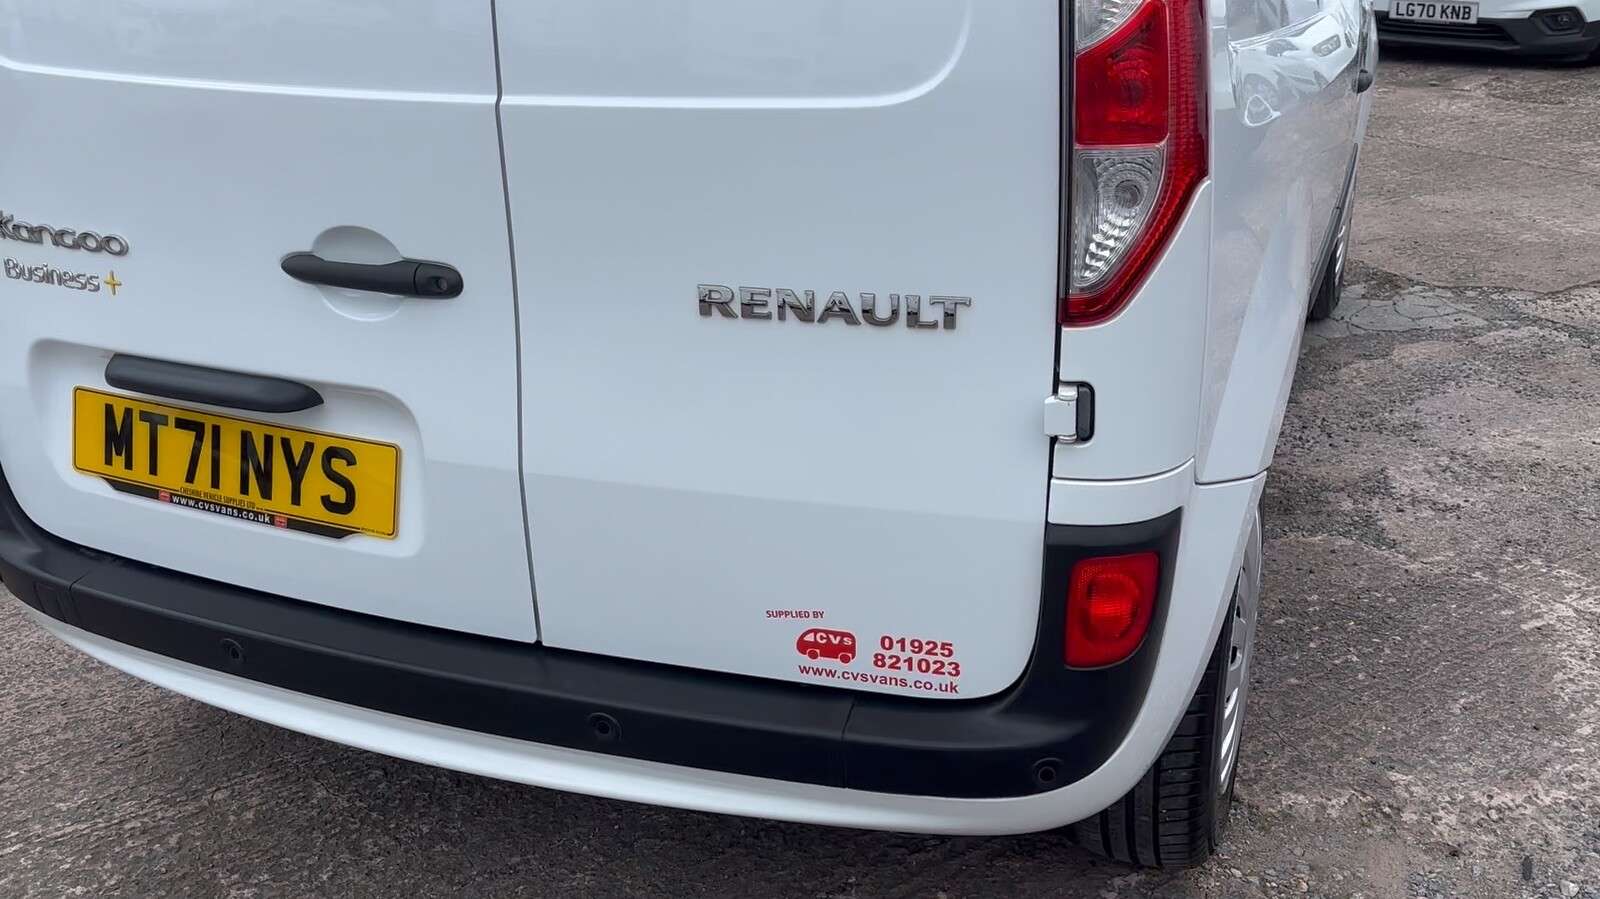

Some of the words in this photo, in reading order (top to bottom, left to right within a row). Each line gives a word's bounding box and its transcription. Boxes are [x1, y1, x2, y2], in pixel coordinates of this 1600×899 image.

[1396, 2, 1436, 18] LG70
[1440, 4, 1472, 20] KNB
[0, 210, 129, 256] Kangoo
[697, 284, 972, 330] RENAULT
[104, 403, 221, 489] MT71
[240, 429, 358, 515] NYS
[171, 495, 271, 523] www.cvsvans.co.uk
[766, 610, 810, 619] SUPPLIED
[812, 611, 825, 619] BY
[815, 632, 853, 646] CVS
[880, 635, 954, 658] 01925
[873, 653, 960, 677] 821023
[798, 665, 959, 694] www.cvsvans.co.uk
